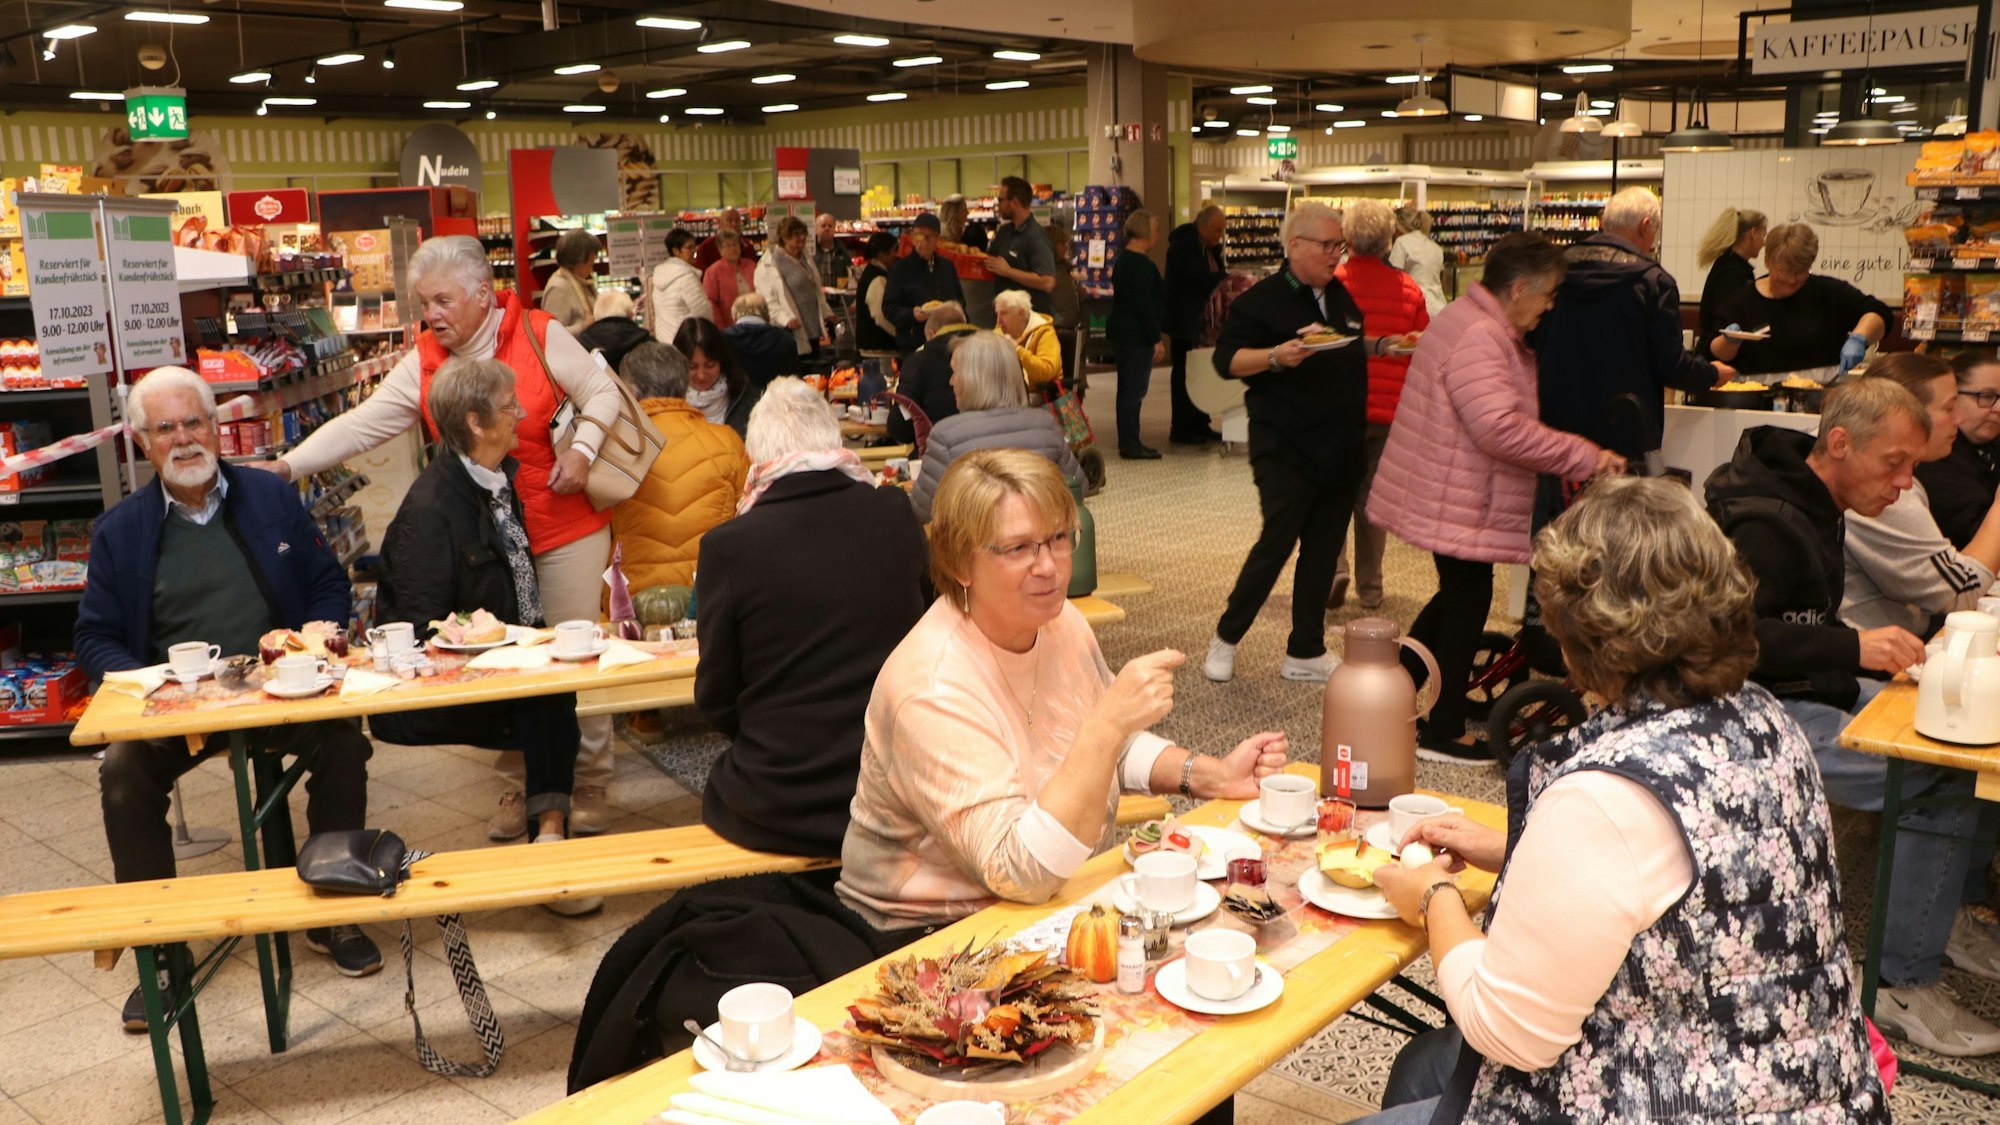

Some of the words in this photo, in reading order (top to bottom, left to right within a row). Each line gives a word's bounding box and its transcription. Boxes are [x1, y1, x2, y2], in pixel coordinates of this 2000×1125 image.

[417, 155, 469, 186] Nudeln
[179, 203, 202, 216] bach
[39, 259, 78, 270] Reserviert
[79, 258, 91, 270] für
[122, 259, 157, 269] Reserviert
[158, 258, 168, 270] für
[1820, 255, 1851, 271] eine
[1854, 255, 1894, 283] gute
[35, 272, 98, 286] Kundenfrühstück
[118, 271, 175, 284] Kundenfrühstück
[49, 305, 93, 320] 17.10.2023
[131, 302, 170, 315] 17.10.2023
[42, 324, 62, 338] 9.00
[67, 322, 89, 335] 12.00
[90, 320, 105, 332] Uhr
[124, 319, 142, 331] 9.00
[146, 317, 166, 329] 12.00
[167, 316, 180, 328] Uhr
